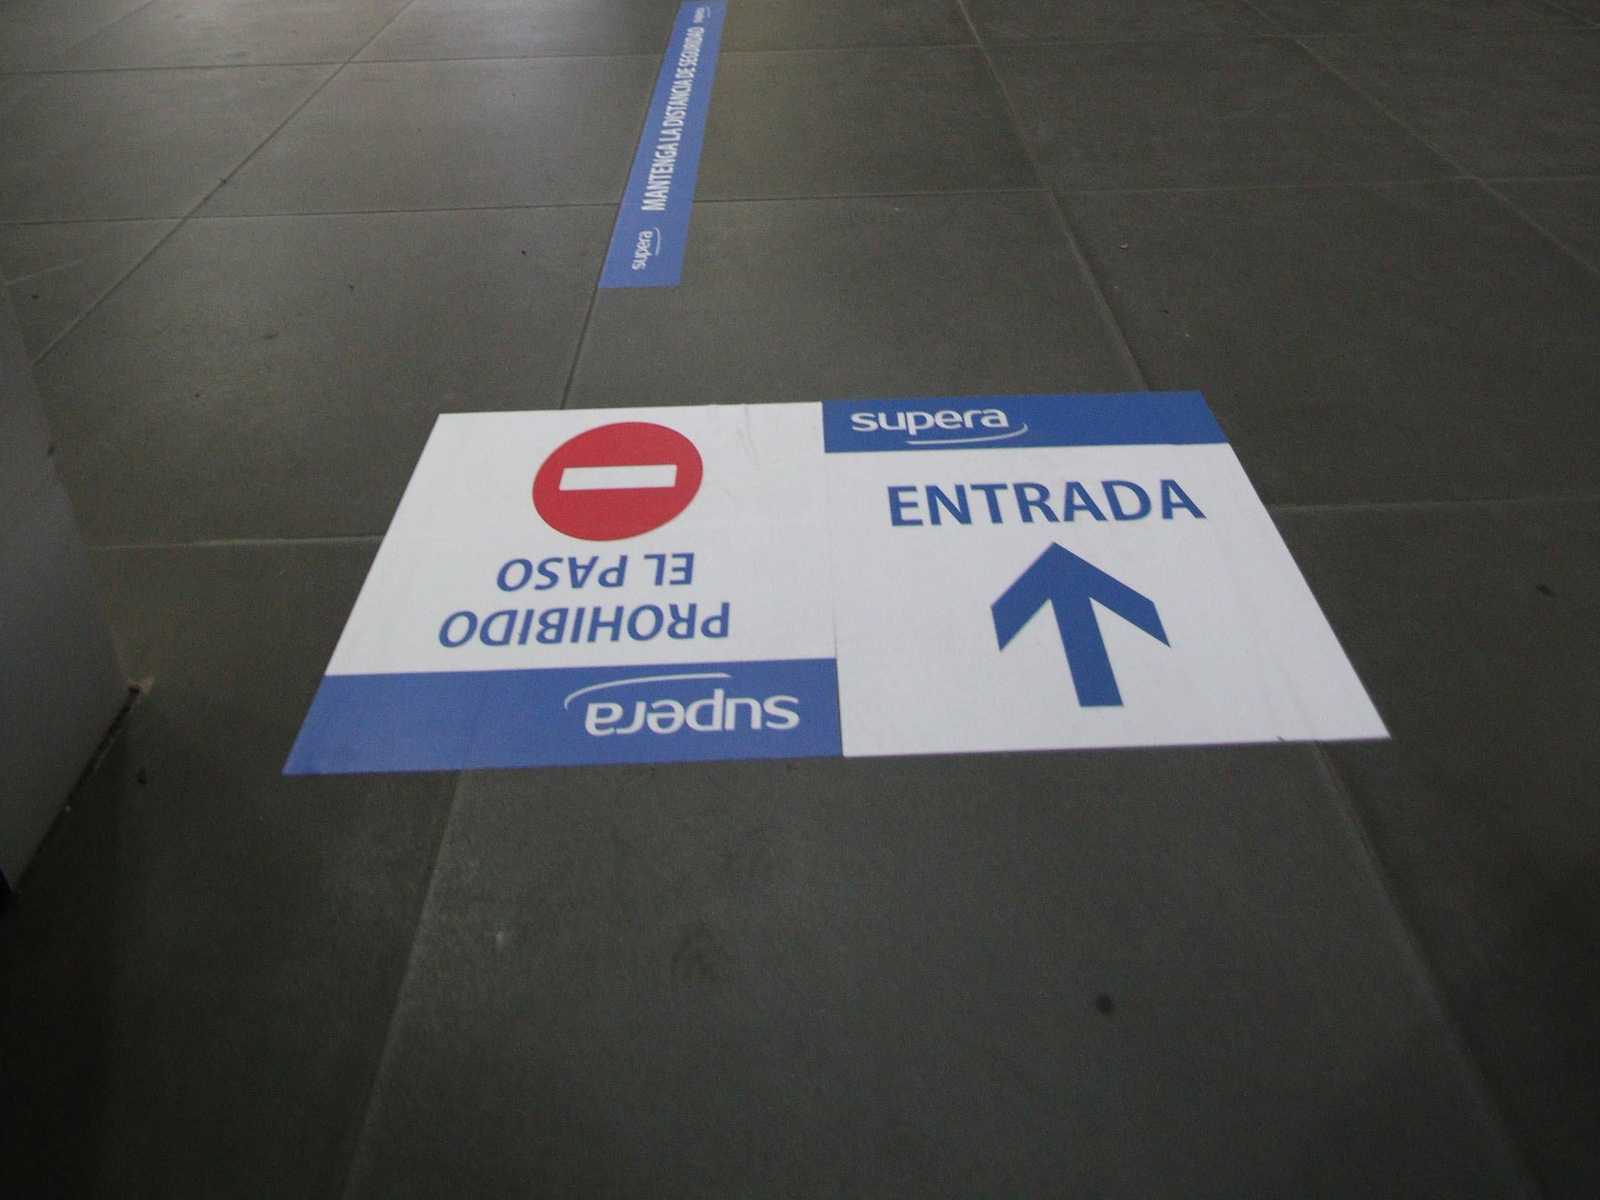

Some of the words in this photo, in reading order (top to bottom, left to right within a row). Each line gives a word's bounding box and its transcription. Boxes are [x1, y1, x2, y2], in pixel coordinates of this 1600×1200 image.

[678, 26, 705, 67] SEGURIDAD
[675, 67, 696, 79] DE
[662, 79, 693, 127] DISTANCIA
[658, 128, 682, 142] LA
[641, 142, 679, 211] MANTENGA
[631, 229, 653, 270] supera
[851, 408, 1010, 436] supera
[887, 479, 1207, 527] ENTRADA
[496, 555, 628, 592] PASO
[644, 552, 695, 586] EL
[438, 602, 730, 648] PROHIBIDO
[584, 688, 800, 736] supera
